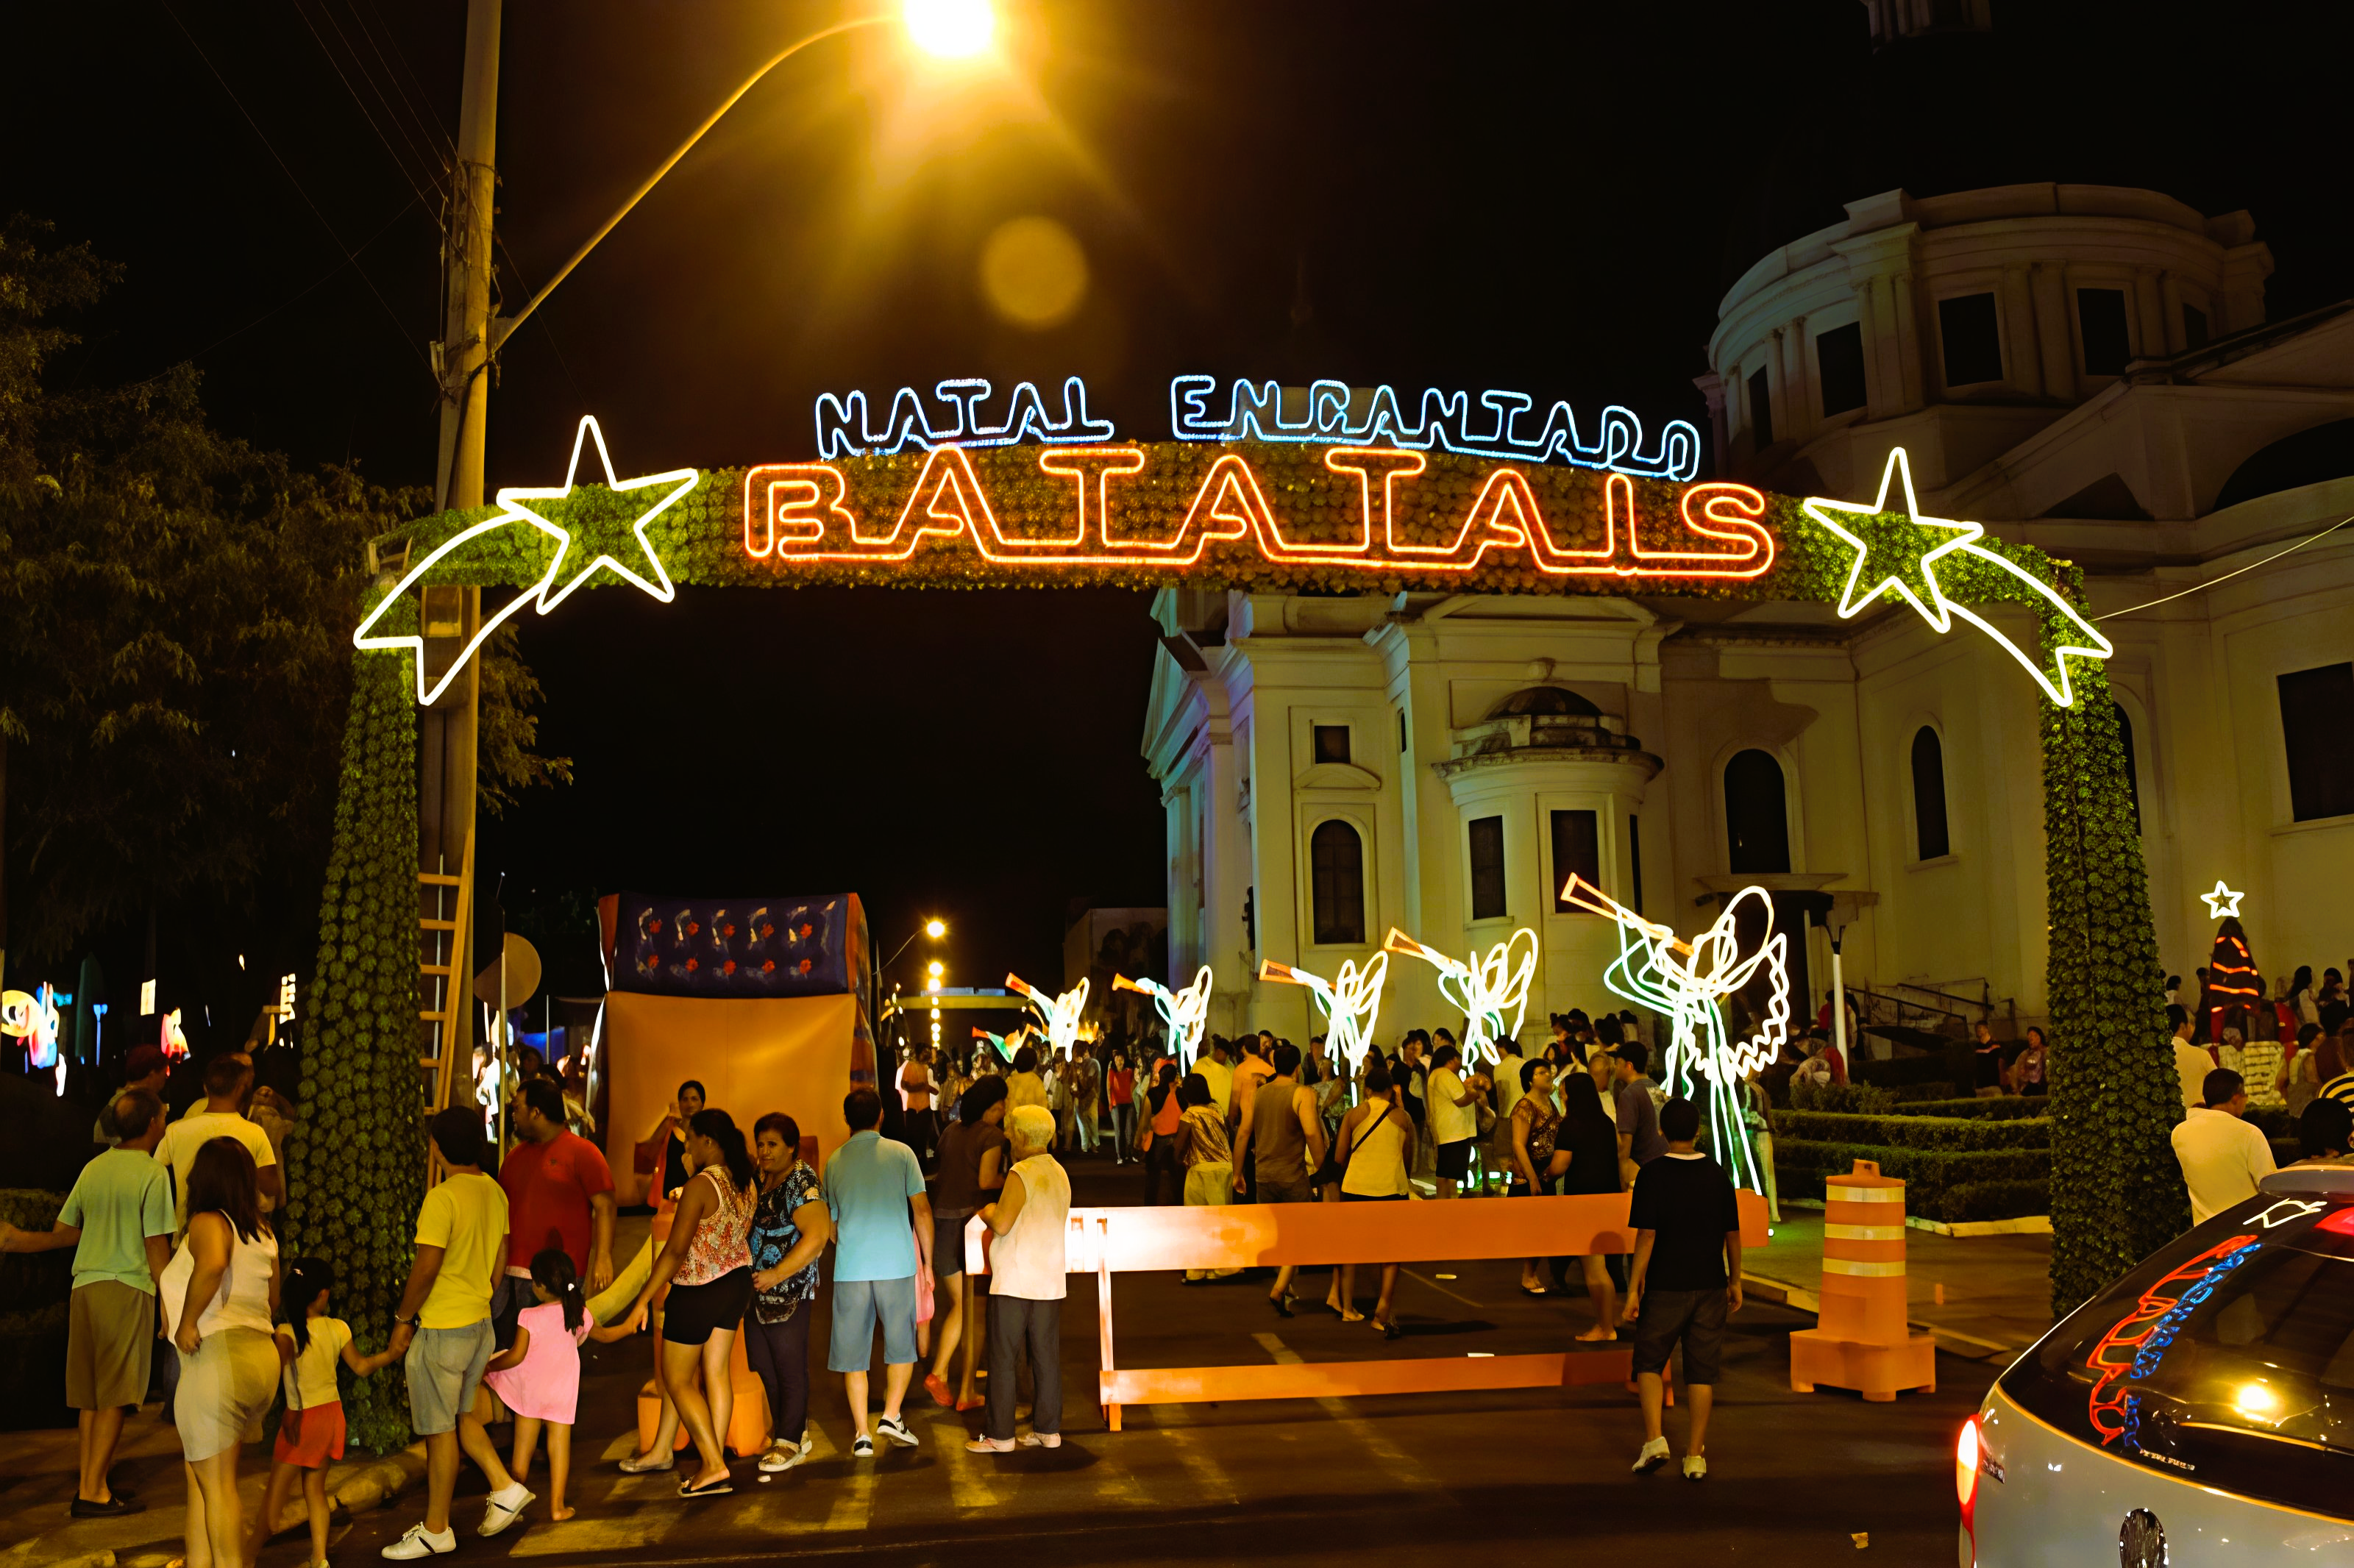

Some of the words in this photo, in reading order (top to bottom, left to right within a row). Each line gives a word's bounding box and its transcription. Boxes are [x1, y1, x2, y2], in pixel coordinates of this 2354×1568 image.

[815, 376, 1115, 461] NATAL
[1170, 374, 1702, 482] ENCANTADO
[744, 442, 1775, 580] BATATAIS
